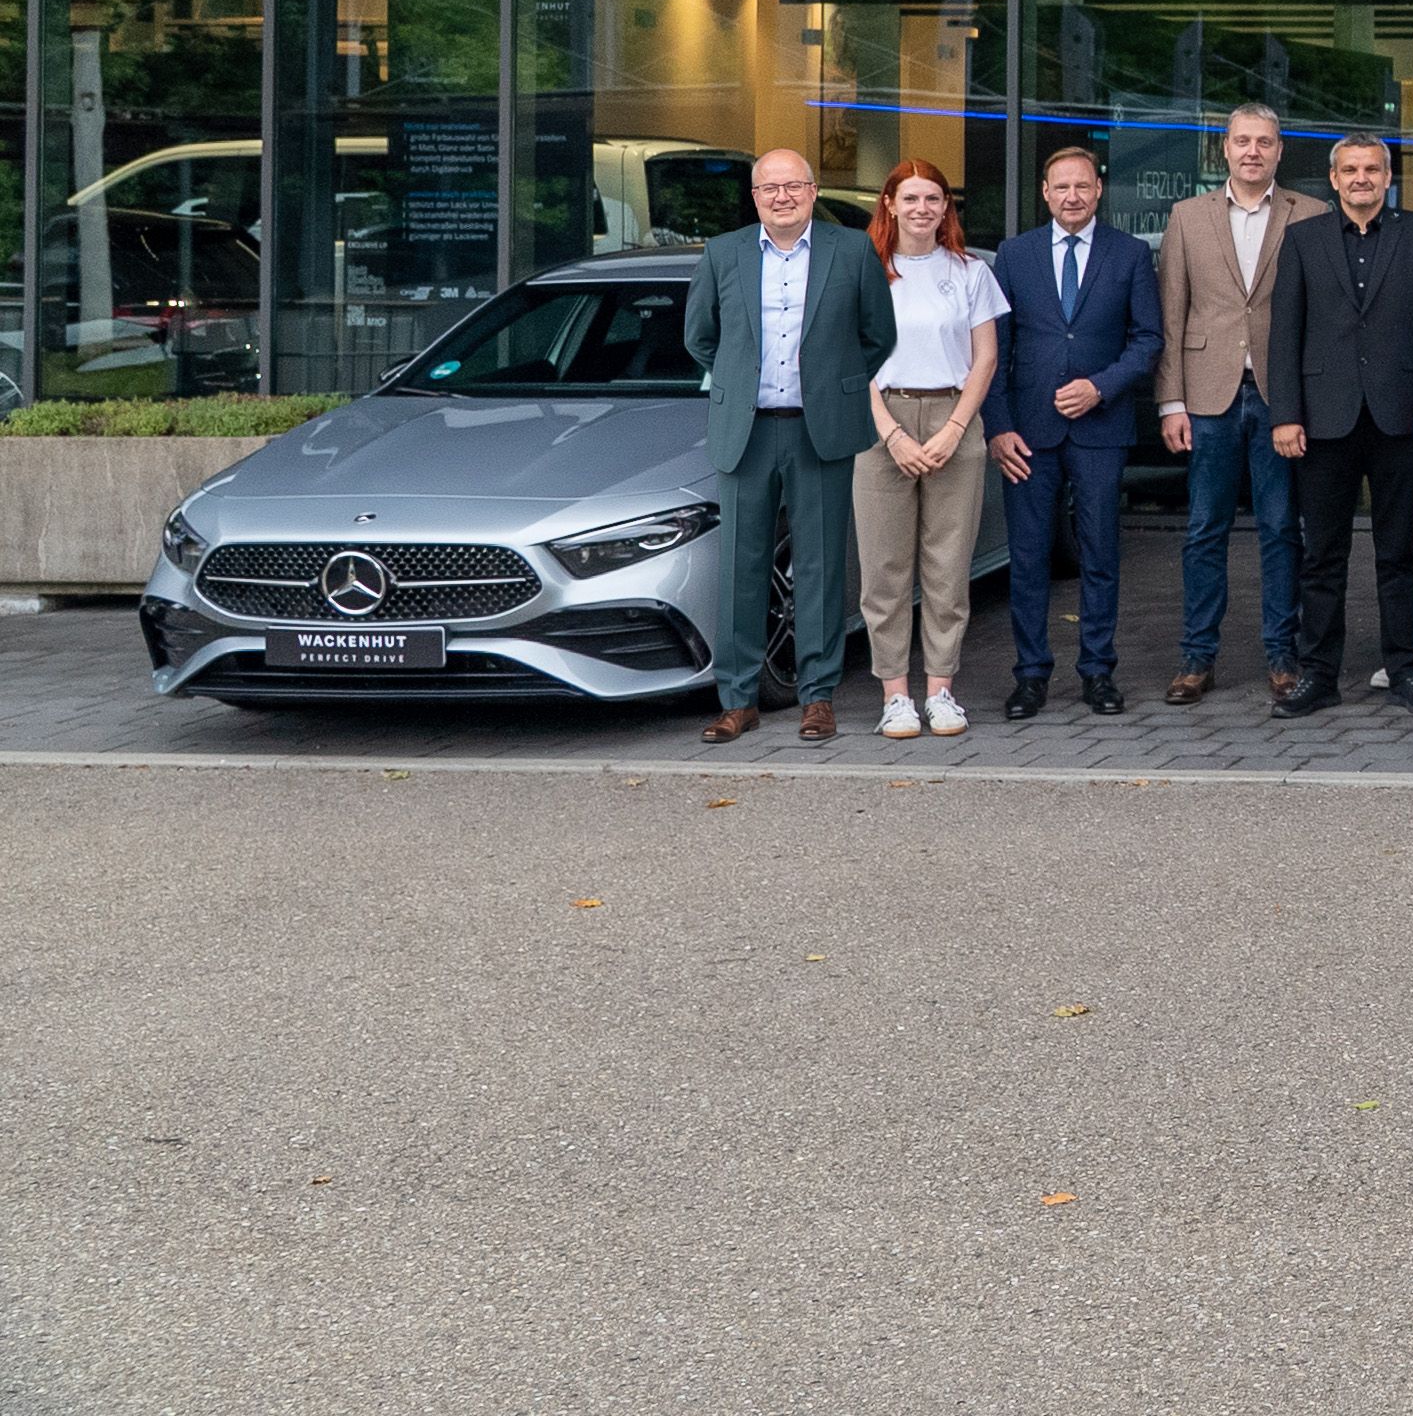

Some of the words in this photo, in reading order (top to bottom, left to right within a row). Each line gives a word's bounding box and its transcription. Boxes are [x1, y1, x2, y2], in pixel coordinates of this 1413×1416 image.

[1136, 170, 1192, 200] HERZLICH
[450, 201, 468, 209] Lack
[1111, 211, 1170, 235] WILLKOM
[440, 287, 459, 298] 3M
[297, 633, 408, 648] WACKENHUT
[300, 652, 358, 663] PERFECT
[364, 654, 406, 664] DRIVE
